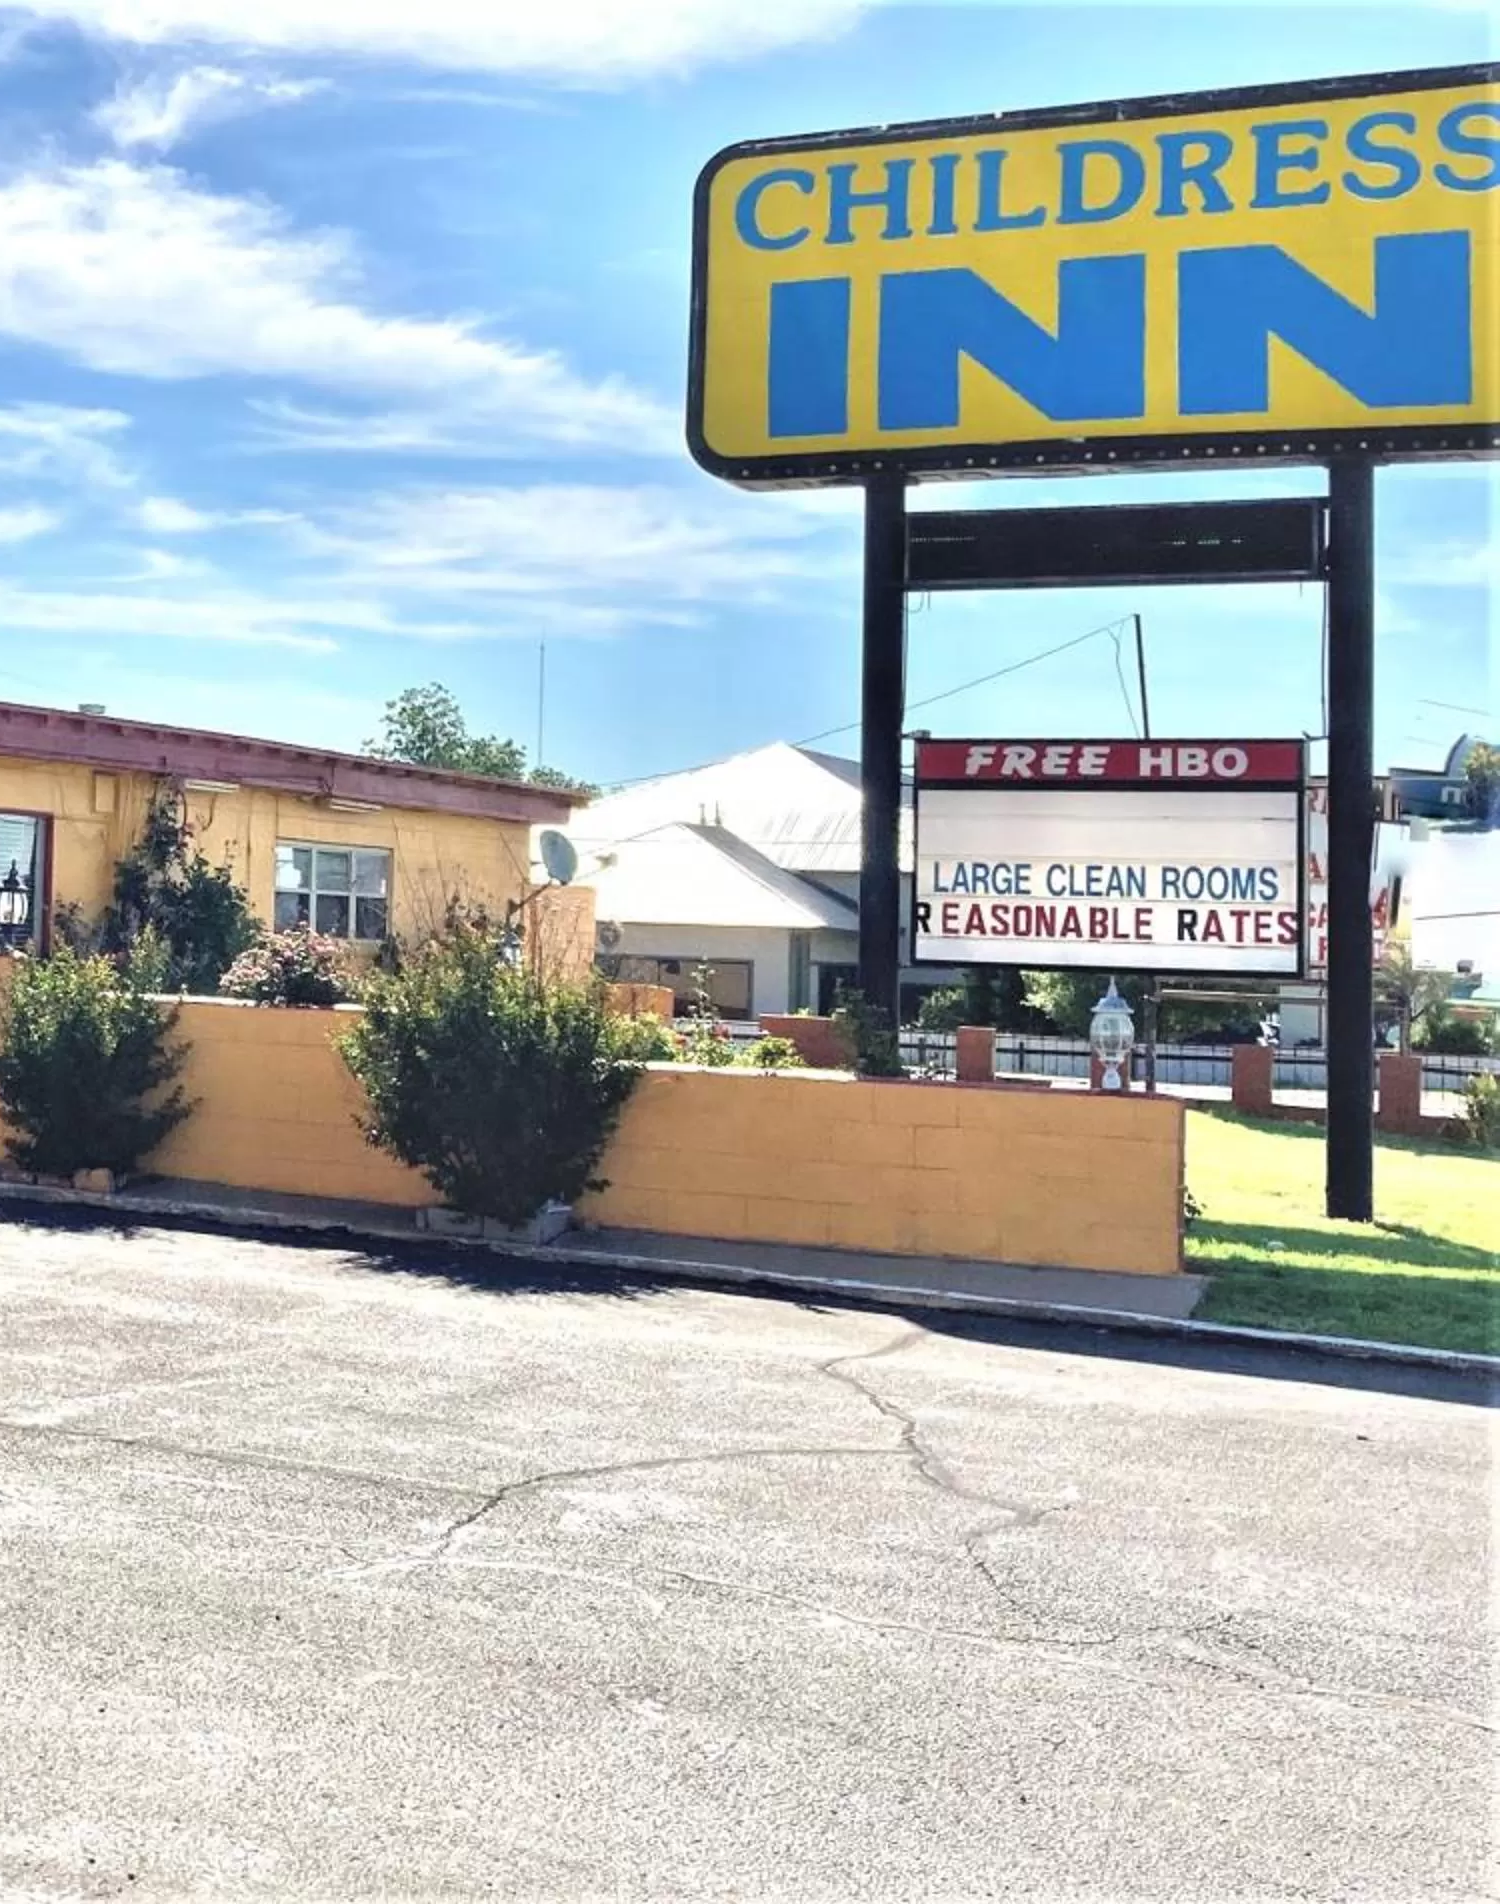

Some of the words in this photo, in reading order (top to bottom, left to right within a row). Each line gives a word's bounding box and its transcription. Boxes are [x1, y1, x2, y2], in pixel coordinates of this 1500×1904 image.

[735, 103, 1500, 250] CHILDRESS
[768, 229, 1472, 438] INN
[965, 745, 1110, 776] FREE
[1138, 747, 1248, 777] HBO
[933, 861, 1032, 895] LARGE
[1045, 864, 1146, 897] CLEAN
[1161, 866, 1279, 901] ROOMS
[916, 901, 1153, 941] REASONABLE
[1177, 908, 1300, 945] RATES
